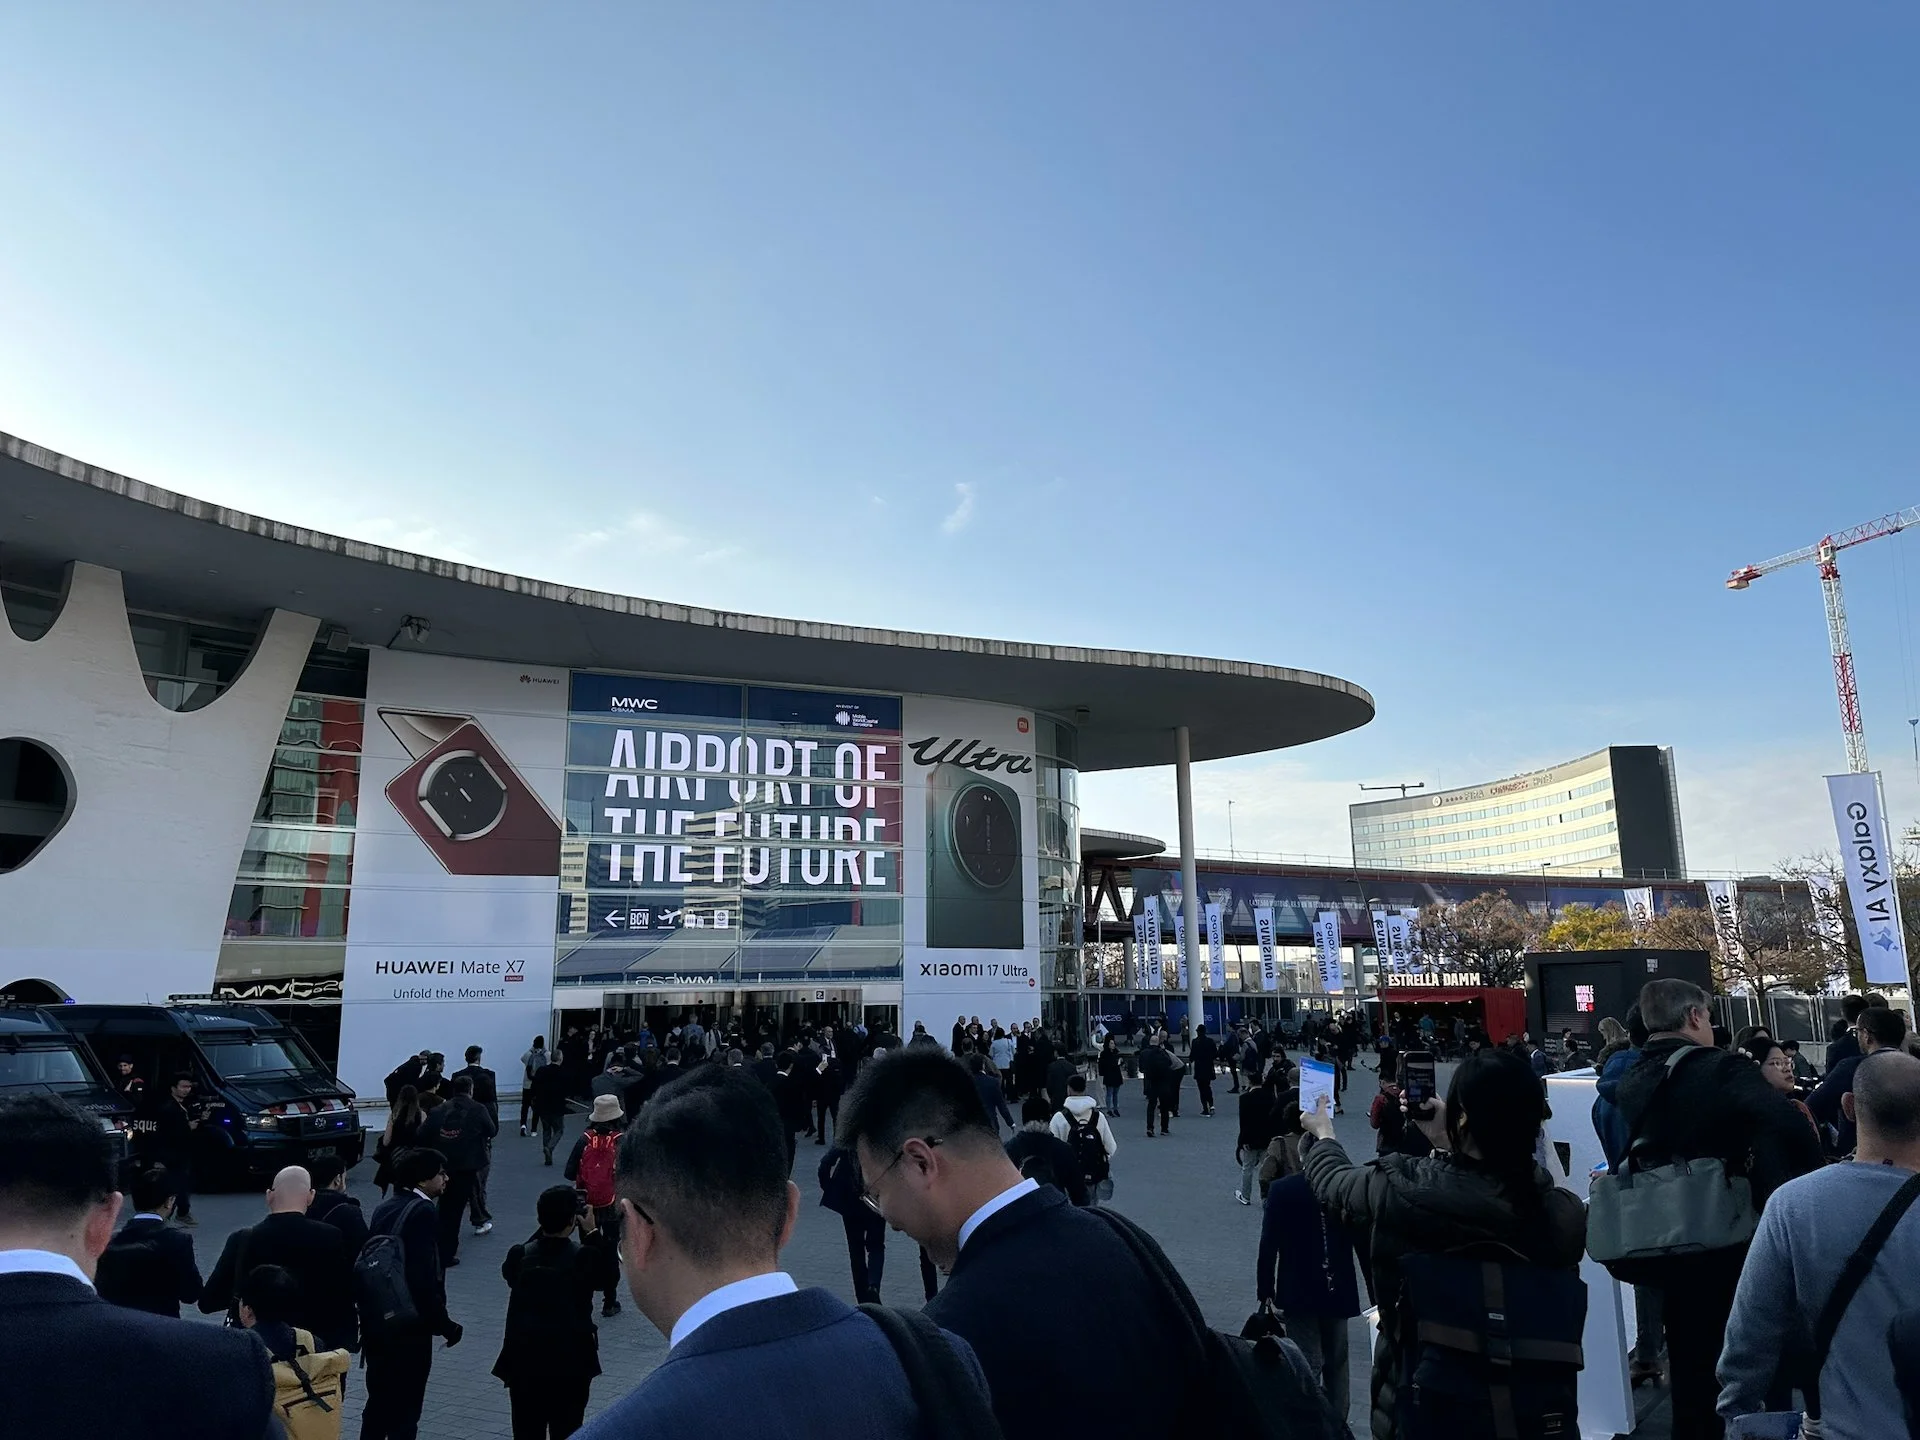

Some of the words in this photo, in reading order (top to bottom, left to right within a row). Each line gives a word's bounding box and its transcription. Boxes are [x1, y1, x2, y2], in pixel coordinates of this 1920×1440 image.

[532, 677, 560, 685] HUAWEI
[611, 696, 658, 710] MWC
[611, 706, 636, 714] GSMA
[908, 736, 1033, 774] Ultra
[604, 728, 818, 805] AIRPORT
[834, 742, 887, 808] OF
[604, 807, 695, 883] THE
[713, 811, 887, 886] FUTURE
[629, 912, 649, 926] BCN
[375, 960, 454, 975] HUAWEI
[461, 960, 501, 975] Mate
[505, 960, 525, 974] X7
[987, 964, 999, 977] 17
[1002, 964, 1028, 977] Ultra
[1388, 972, 1440, 987] ESTRELLA
[1443, 972, 1481, 987] DAMM
[393, 987, 432, 999] Unfold
[436, 988, 454, 999] the
[458, 987, 505, 998] Moment
